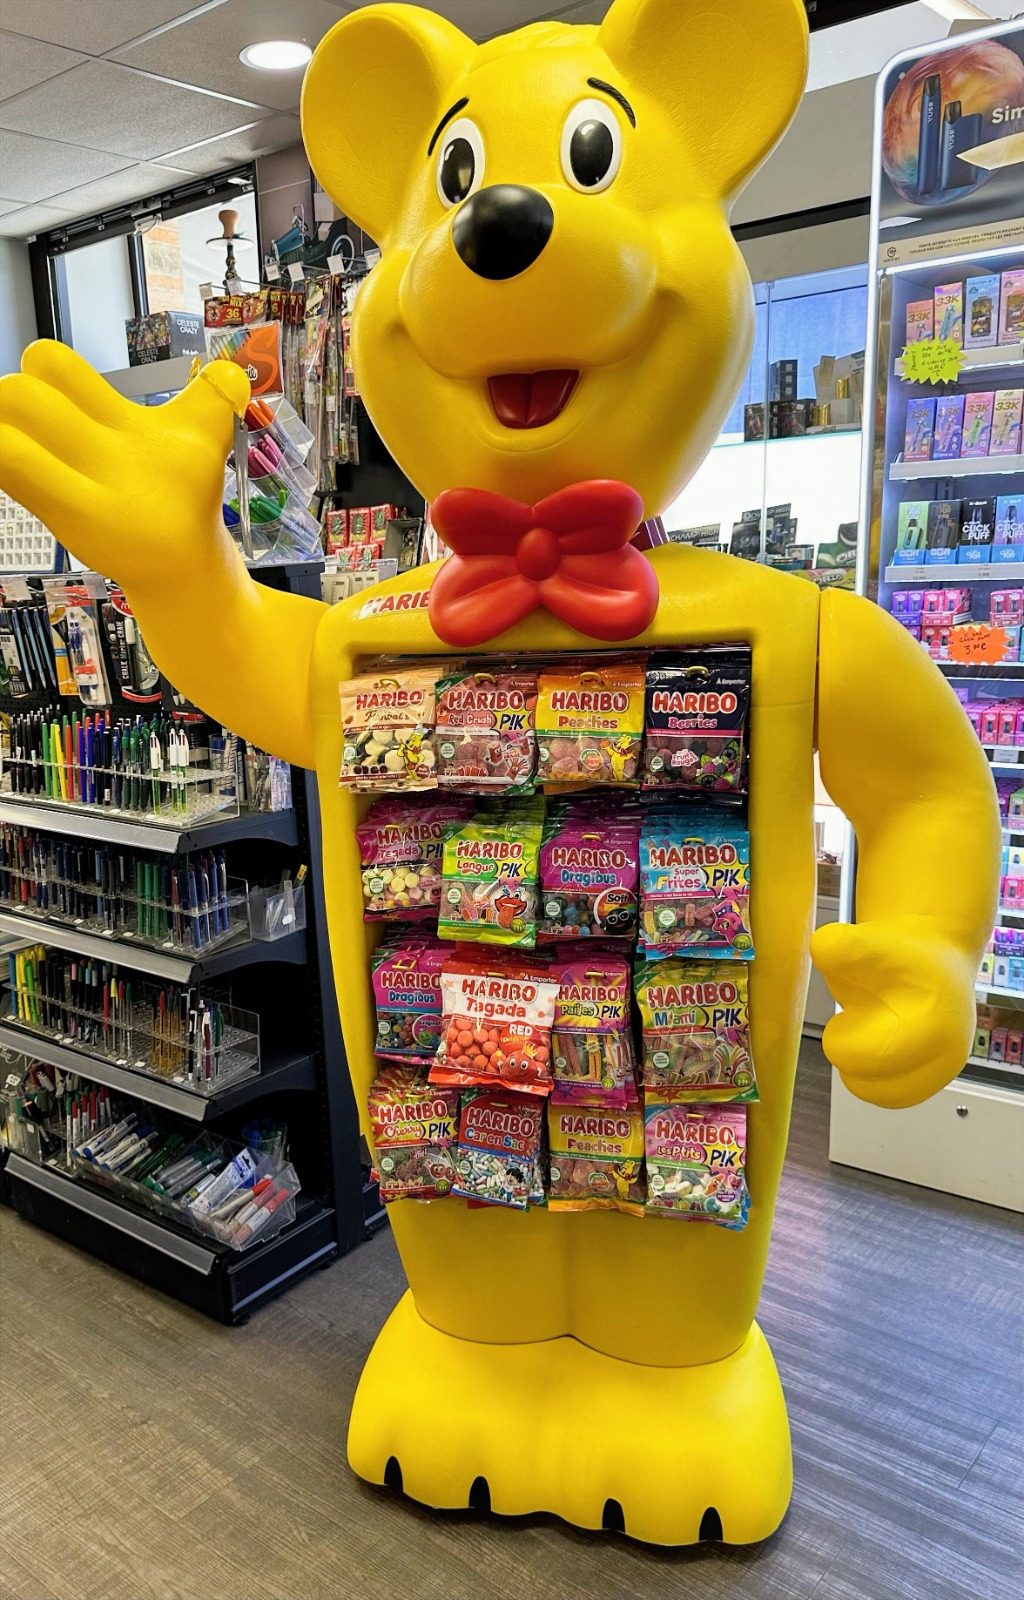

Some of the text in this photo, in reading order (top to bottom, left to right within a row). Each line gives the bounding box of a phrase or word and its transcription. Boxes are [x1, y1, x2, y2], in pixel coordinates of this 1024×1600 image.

[226, 308, 240, 318] 36
[356, 690, 423, 711] HARIBO
[448, 690, 524, 711] HARIBO
[551, 691, 629, 712] HARIBO
[652, 691, 737, 714] HARIBO
[448, 713, 492, 726] Red Crush
[558, 714, 618, 729] Peaches
[668, 714, 718, 729] Berries
[377, 823, 443, 845] HARIBO
[456, 840, 523, 859] HARIBO
[552, 848, 627, 869] HARIBO
[650, 844, 736, 867] HARIBO
[456, 860, 494, 875] Langue
[674, 868, 699, 876] Super
[560, 869, 616, 886] Dragibus
[656, 875, 702, 889] Frites
[607, 893, 629, 904] Soft
[389, 990, 435, 1005] Dragibus
[461, 978, 537, 1003] HARIBO
[558, 985, 620, 1003] HARIBO
[647, 982, 737, 1009] HARIBO
[466, 997, 526, 1018] Tagada
[654, 1009, 697, 1027] Miami
[509, 1024, 533, 1036] RED
[379, 1100, 448, 1124] HARIBO
[467, 1106, 534, 1137] HARIBO
[560, 1115, 631, 1137] HARIBO
[383, 1124, 423, 1139] Cherry
[465, 1128, 488, 1142] Car
[503, 1136, 525, 1151] Sac
[656, 1121, 735, 1145] HARIBO
[567, 1138, 622, 1153] Peaches
[656, 1146, 672, 1156] Les
